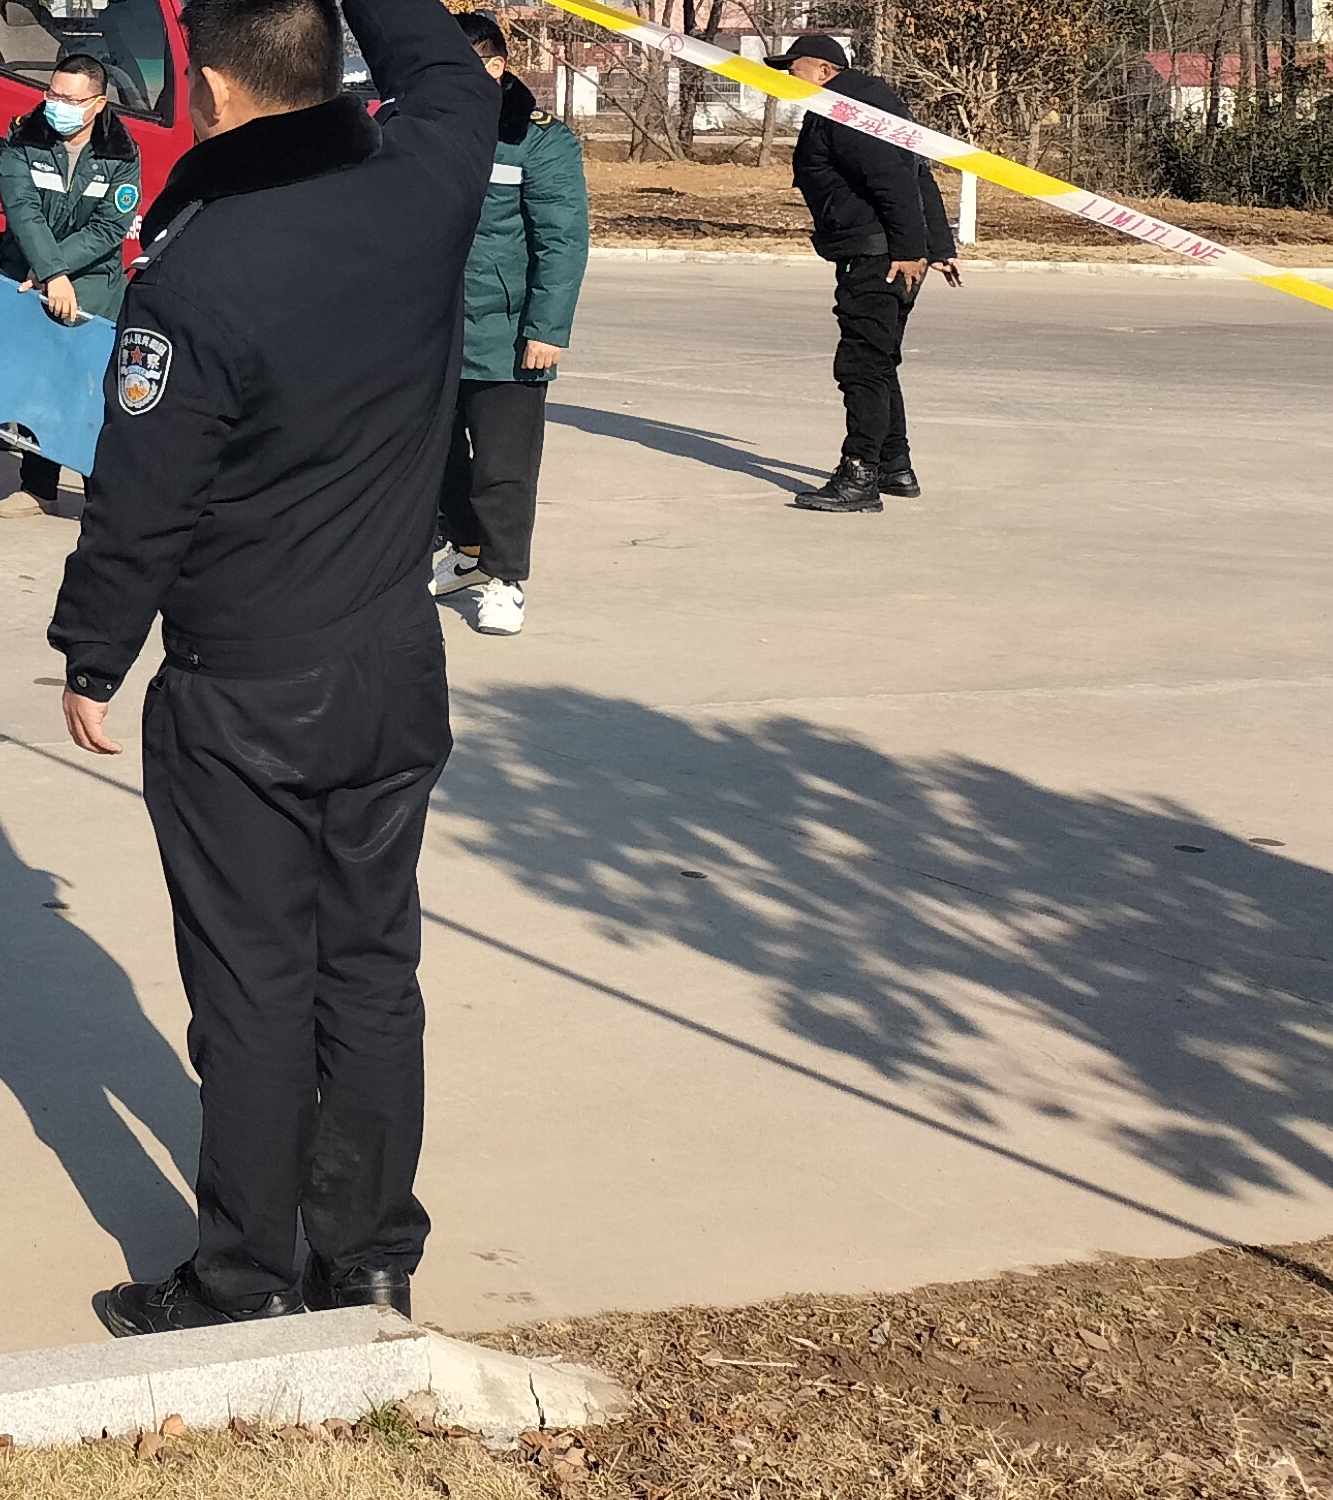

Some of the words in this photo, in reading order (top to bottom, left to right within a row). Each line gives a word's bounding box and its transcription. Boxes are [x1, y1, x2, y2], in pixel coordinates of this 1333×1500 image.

[828, 99, 925, 150] 警戒线
[1077, 198, 1227, 264] LIMITLINE
